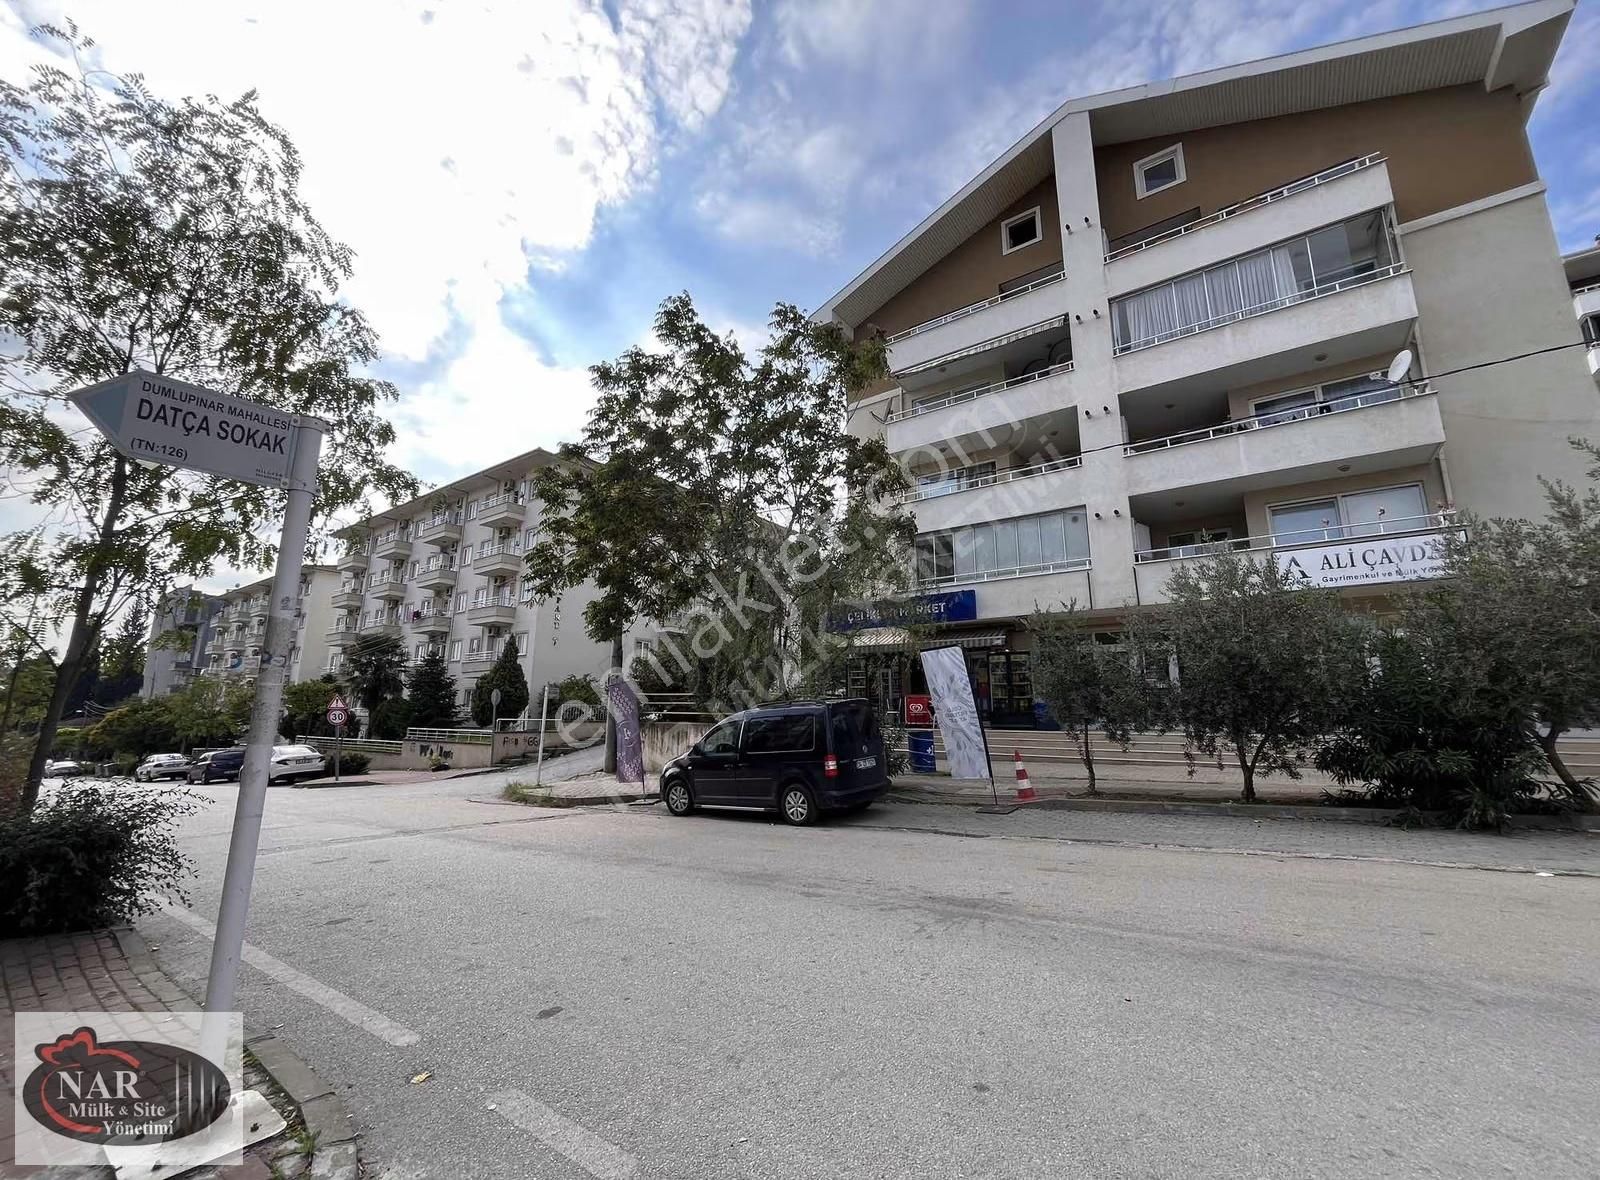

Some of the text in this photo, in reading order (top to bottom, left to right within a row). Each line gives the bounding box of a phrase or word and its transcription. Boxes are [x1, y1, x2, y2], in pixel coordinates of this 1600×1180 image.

[142, 381, 291, 432] DUMLUPINAR MAHALLESİ
[136, 398, 287, 455] DATÇA SOKAK
[130, 437, 188, 461] (TN:126)
[1320, 541, 1440, 571] ALİ ÇAVD
[1322, 571, 1380, 583] Gayrimenkul
[1382, 571, 1393, 579] ve
[899, 602, 946, 617] MRKET
[331, 712, 344, 722] 30
